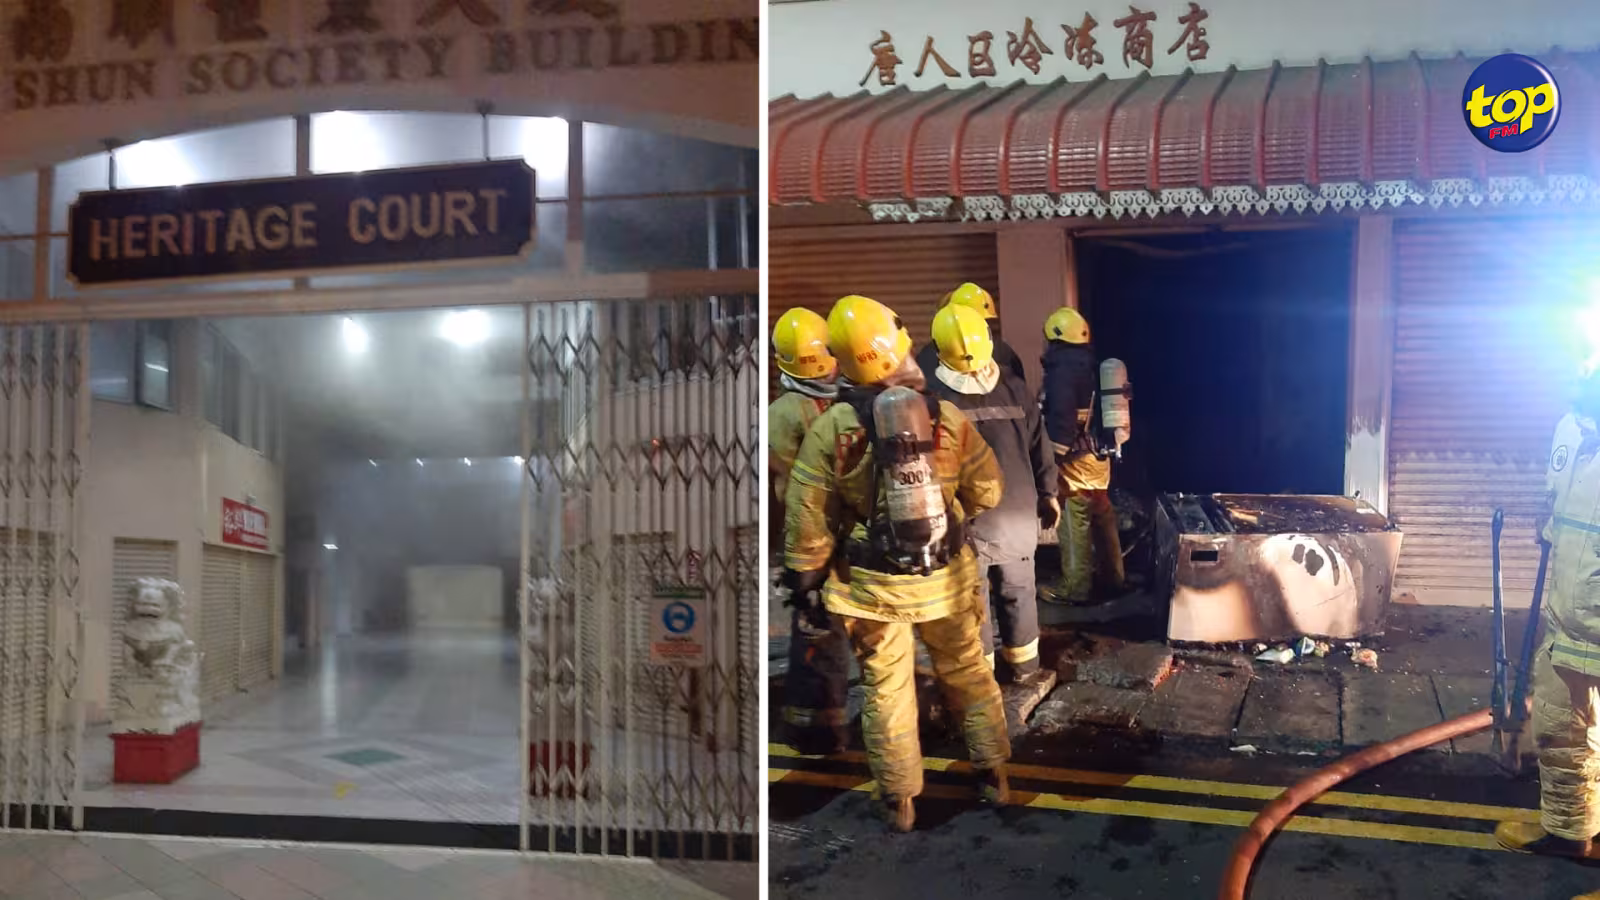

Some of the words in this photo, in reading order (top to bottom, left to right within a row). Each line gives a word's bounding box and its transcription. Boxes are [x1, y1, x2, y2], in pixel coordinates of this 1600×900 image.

[13, 60, 155, 111] SHUN
[185, 37, 450, 96] SOCIETY
[88, 202, 318, 262] HERITAGE
[347, 188, 507, 245] COURT
